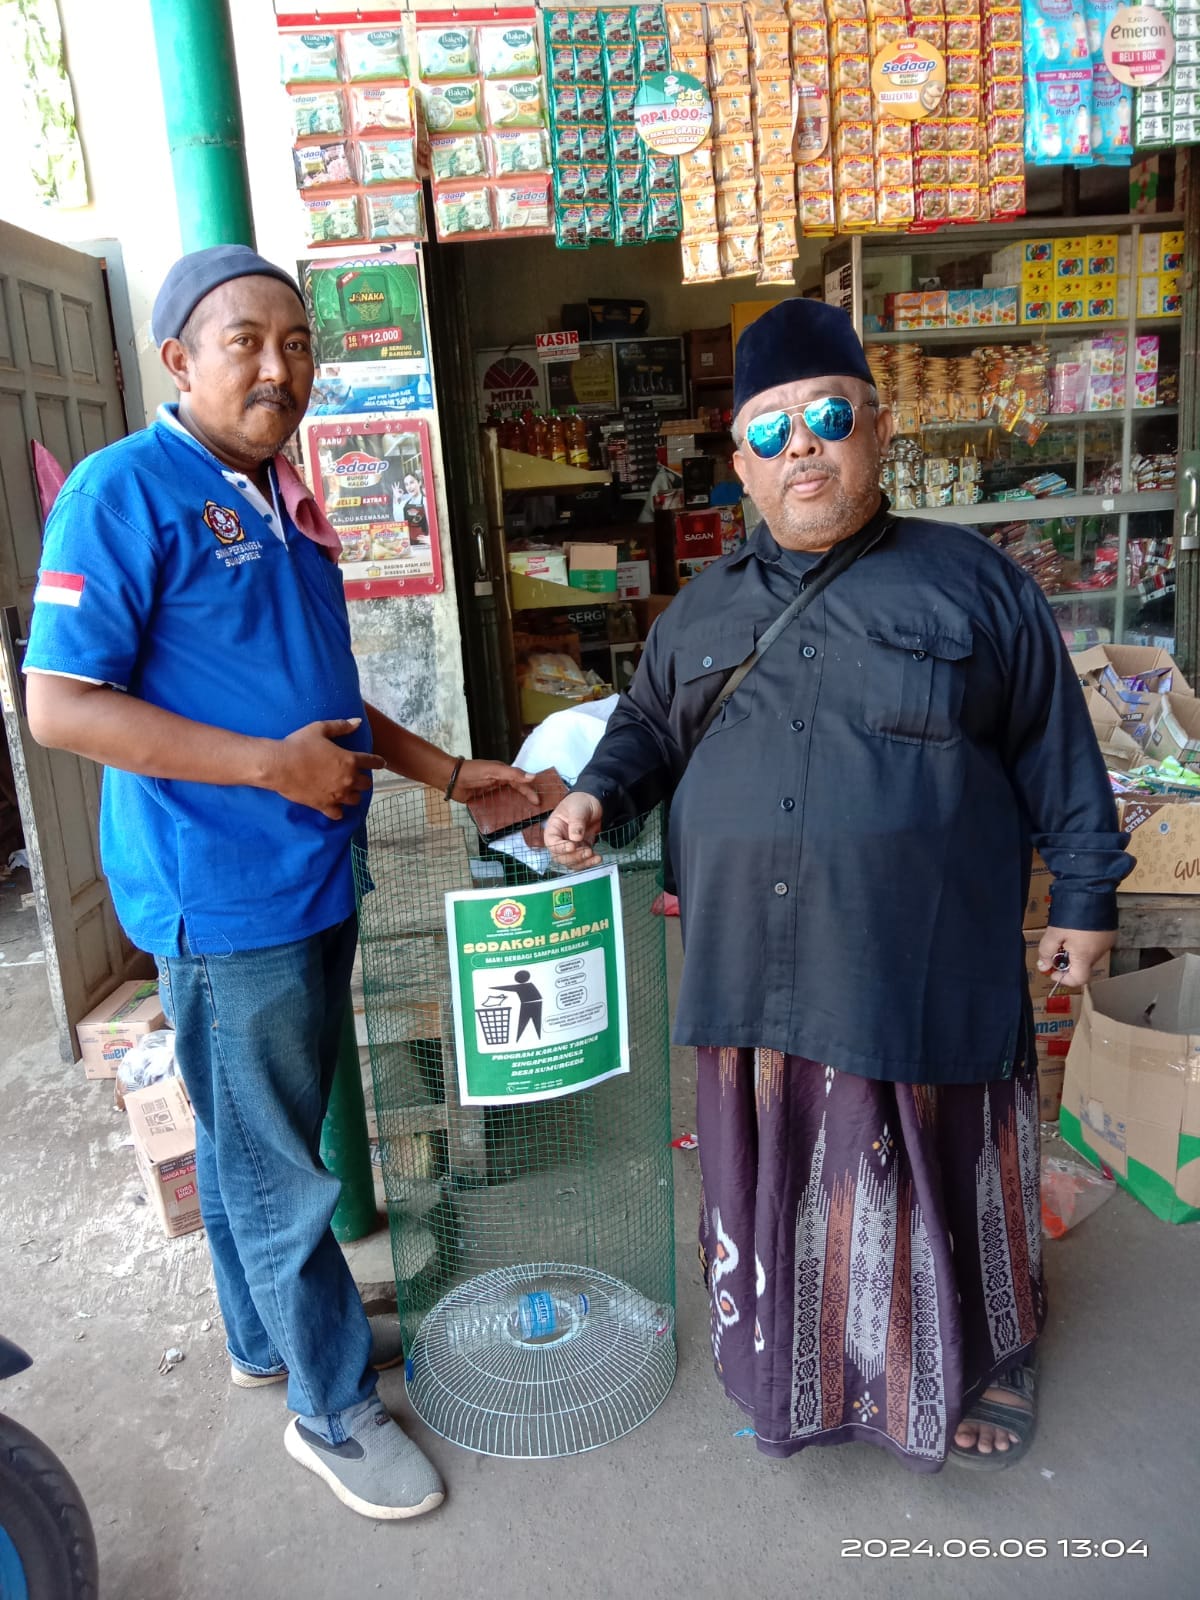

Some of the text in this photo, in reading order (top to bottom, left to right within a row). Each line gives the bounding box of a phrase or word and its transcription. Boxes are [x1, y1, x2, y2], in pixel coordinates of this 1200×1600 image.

[1111, 24, 1166, 40] emeron
[1142, 50, 1157, 61] BOX
[881, 60, 936, 73] Sedaap
[640, 111, 659, 127] RP
[675, 127, 705, 137] GRATIS
[536, 332, 578, 348] KASIR
[490, 389, 533, 402] MITRA
[321, 438, 342, 446] BARU
[326, 461, 389, 474] Sedaap
[362, 497, 383, 505] EXTRA
[684, 531, 714, 542] SAGAN
[1124, 815, 1146, 833] EXTRA
[463, 935, 546, 954] SODAKOH
[549, 918, 610, 944] SAMPAH
[485, 940, 590, 964] MARI BERBAGI SAMPAH KEBAIKAN
[491, 1051, 535, 1061] PROGRAM
[535, 1044, 569, 1057] KARANG
[511, 1049, 584, 1068] SINGAPERBANGSA
[511, 1057, 585, 1077] DESA SUMURGEDE
